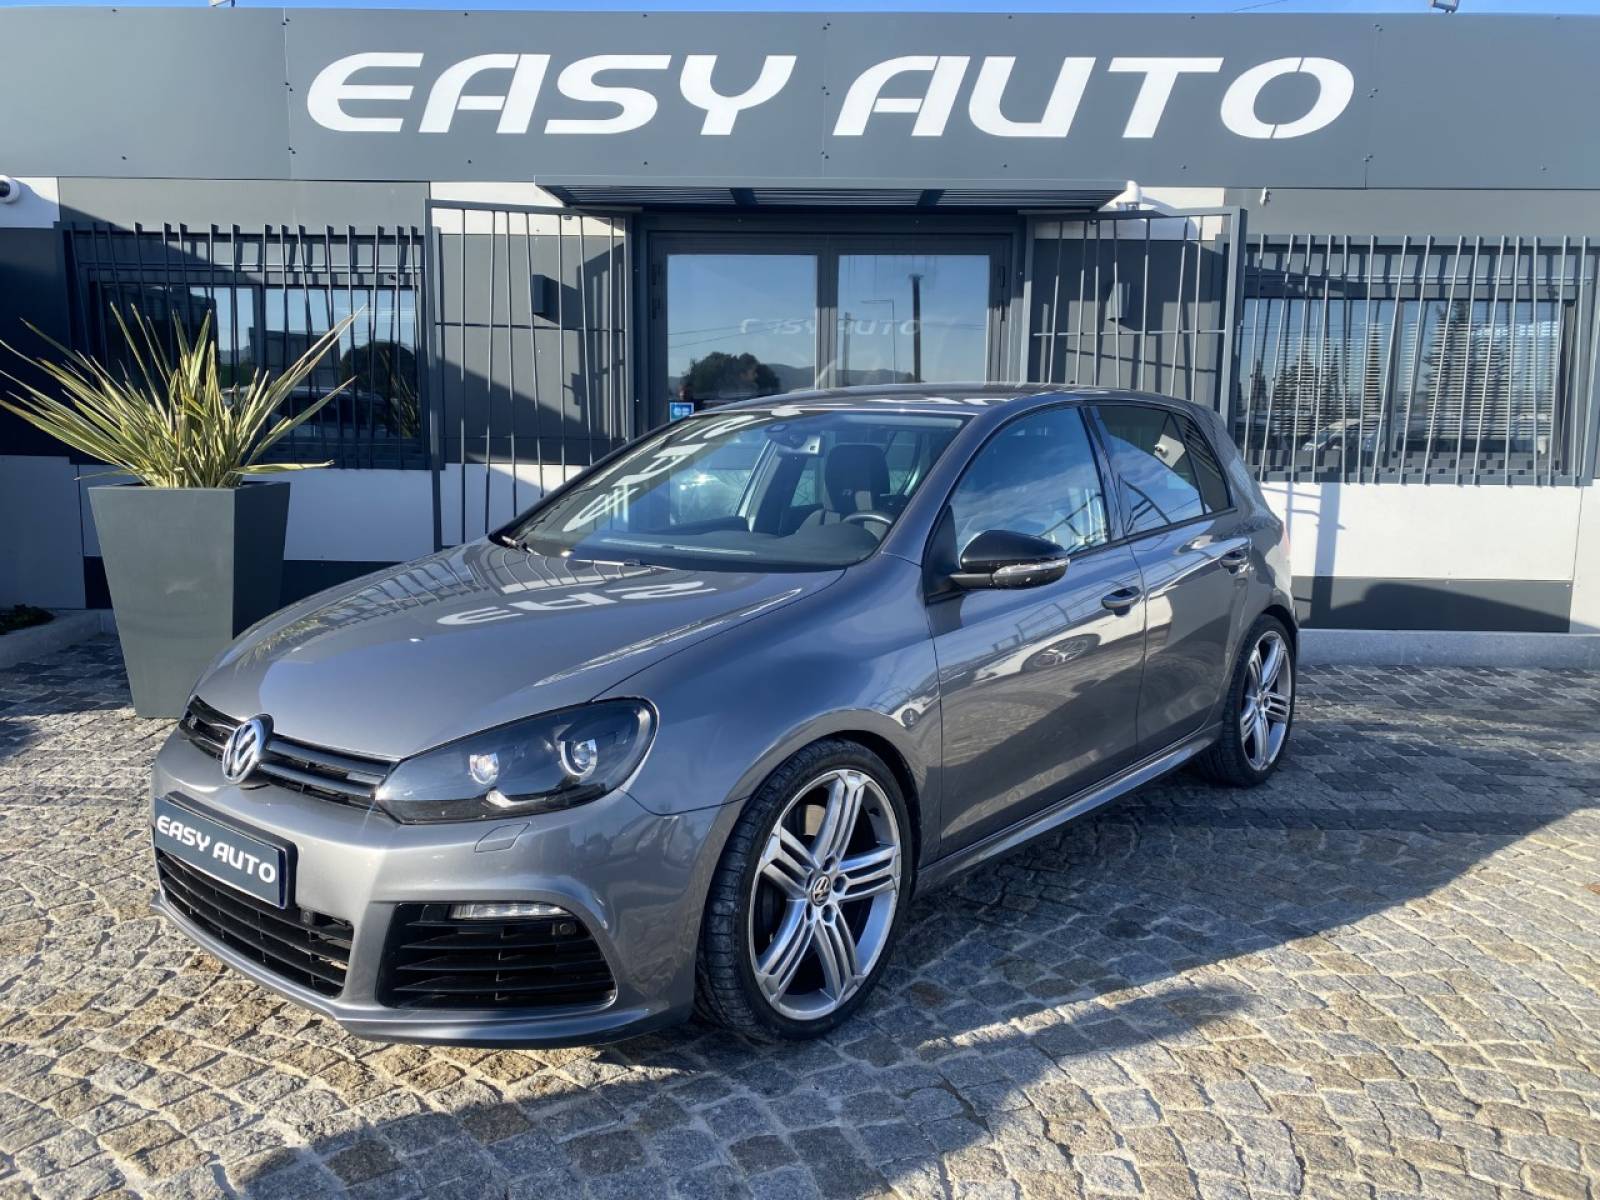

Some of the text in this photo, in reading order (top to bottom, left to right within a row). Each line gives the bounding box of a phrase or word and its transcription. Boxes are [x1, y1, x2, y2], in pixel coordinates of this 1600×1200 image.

[307, 52, 1355, 139] EASY AUTO
[157, 815, 276, 884] EASY AUTO
